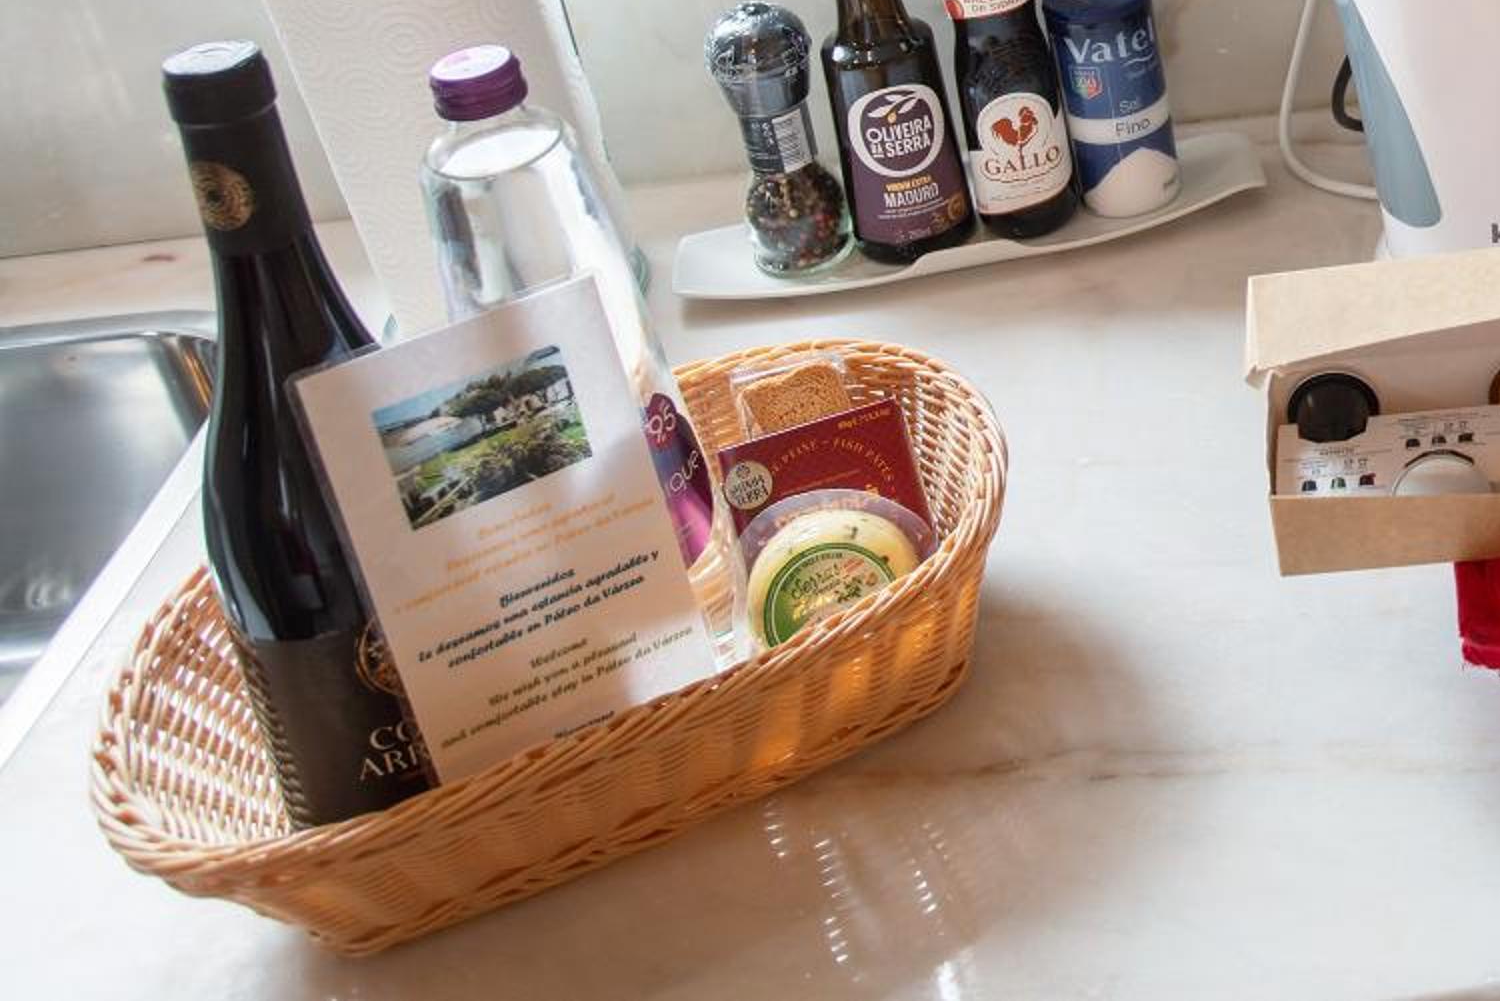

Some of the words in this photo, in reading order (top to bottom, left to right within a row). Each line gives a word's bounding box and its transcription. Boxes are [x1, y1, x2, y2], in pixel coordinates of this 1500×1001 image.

[1064, 14, 1155, 65] Vatel
[866, 114, 933, 144] OLIVEIRA
[1115, 117, 1151, 137] Fino
[885, 132, 932, 159] SERRA
[984, 145, 1061, 176] GALLO
[883, 182, 940, 208] MADURO
